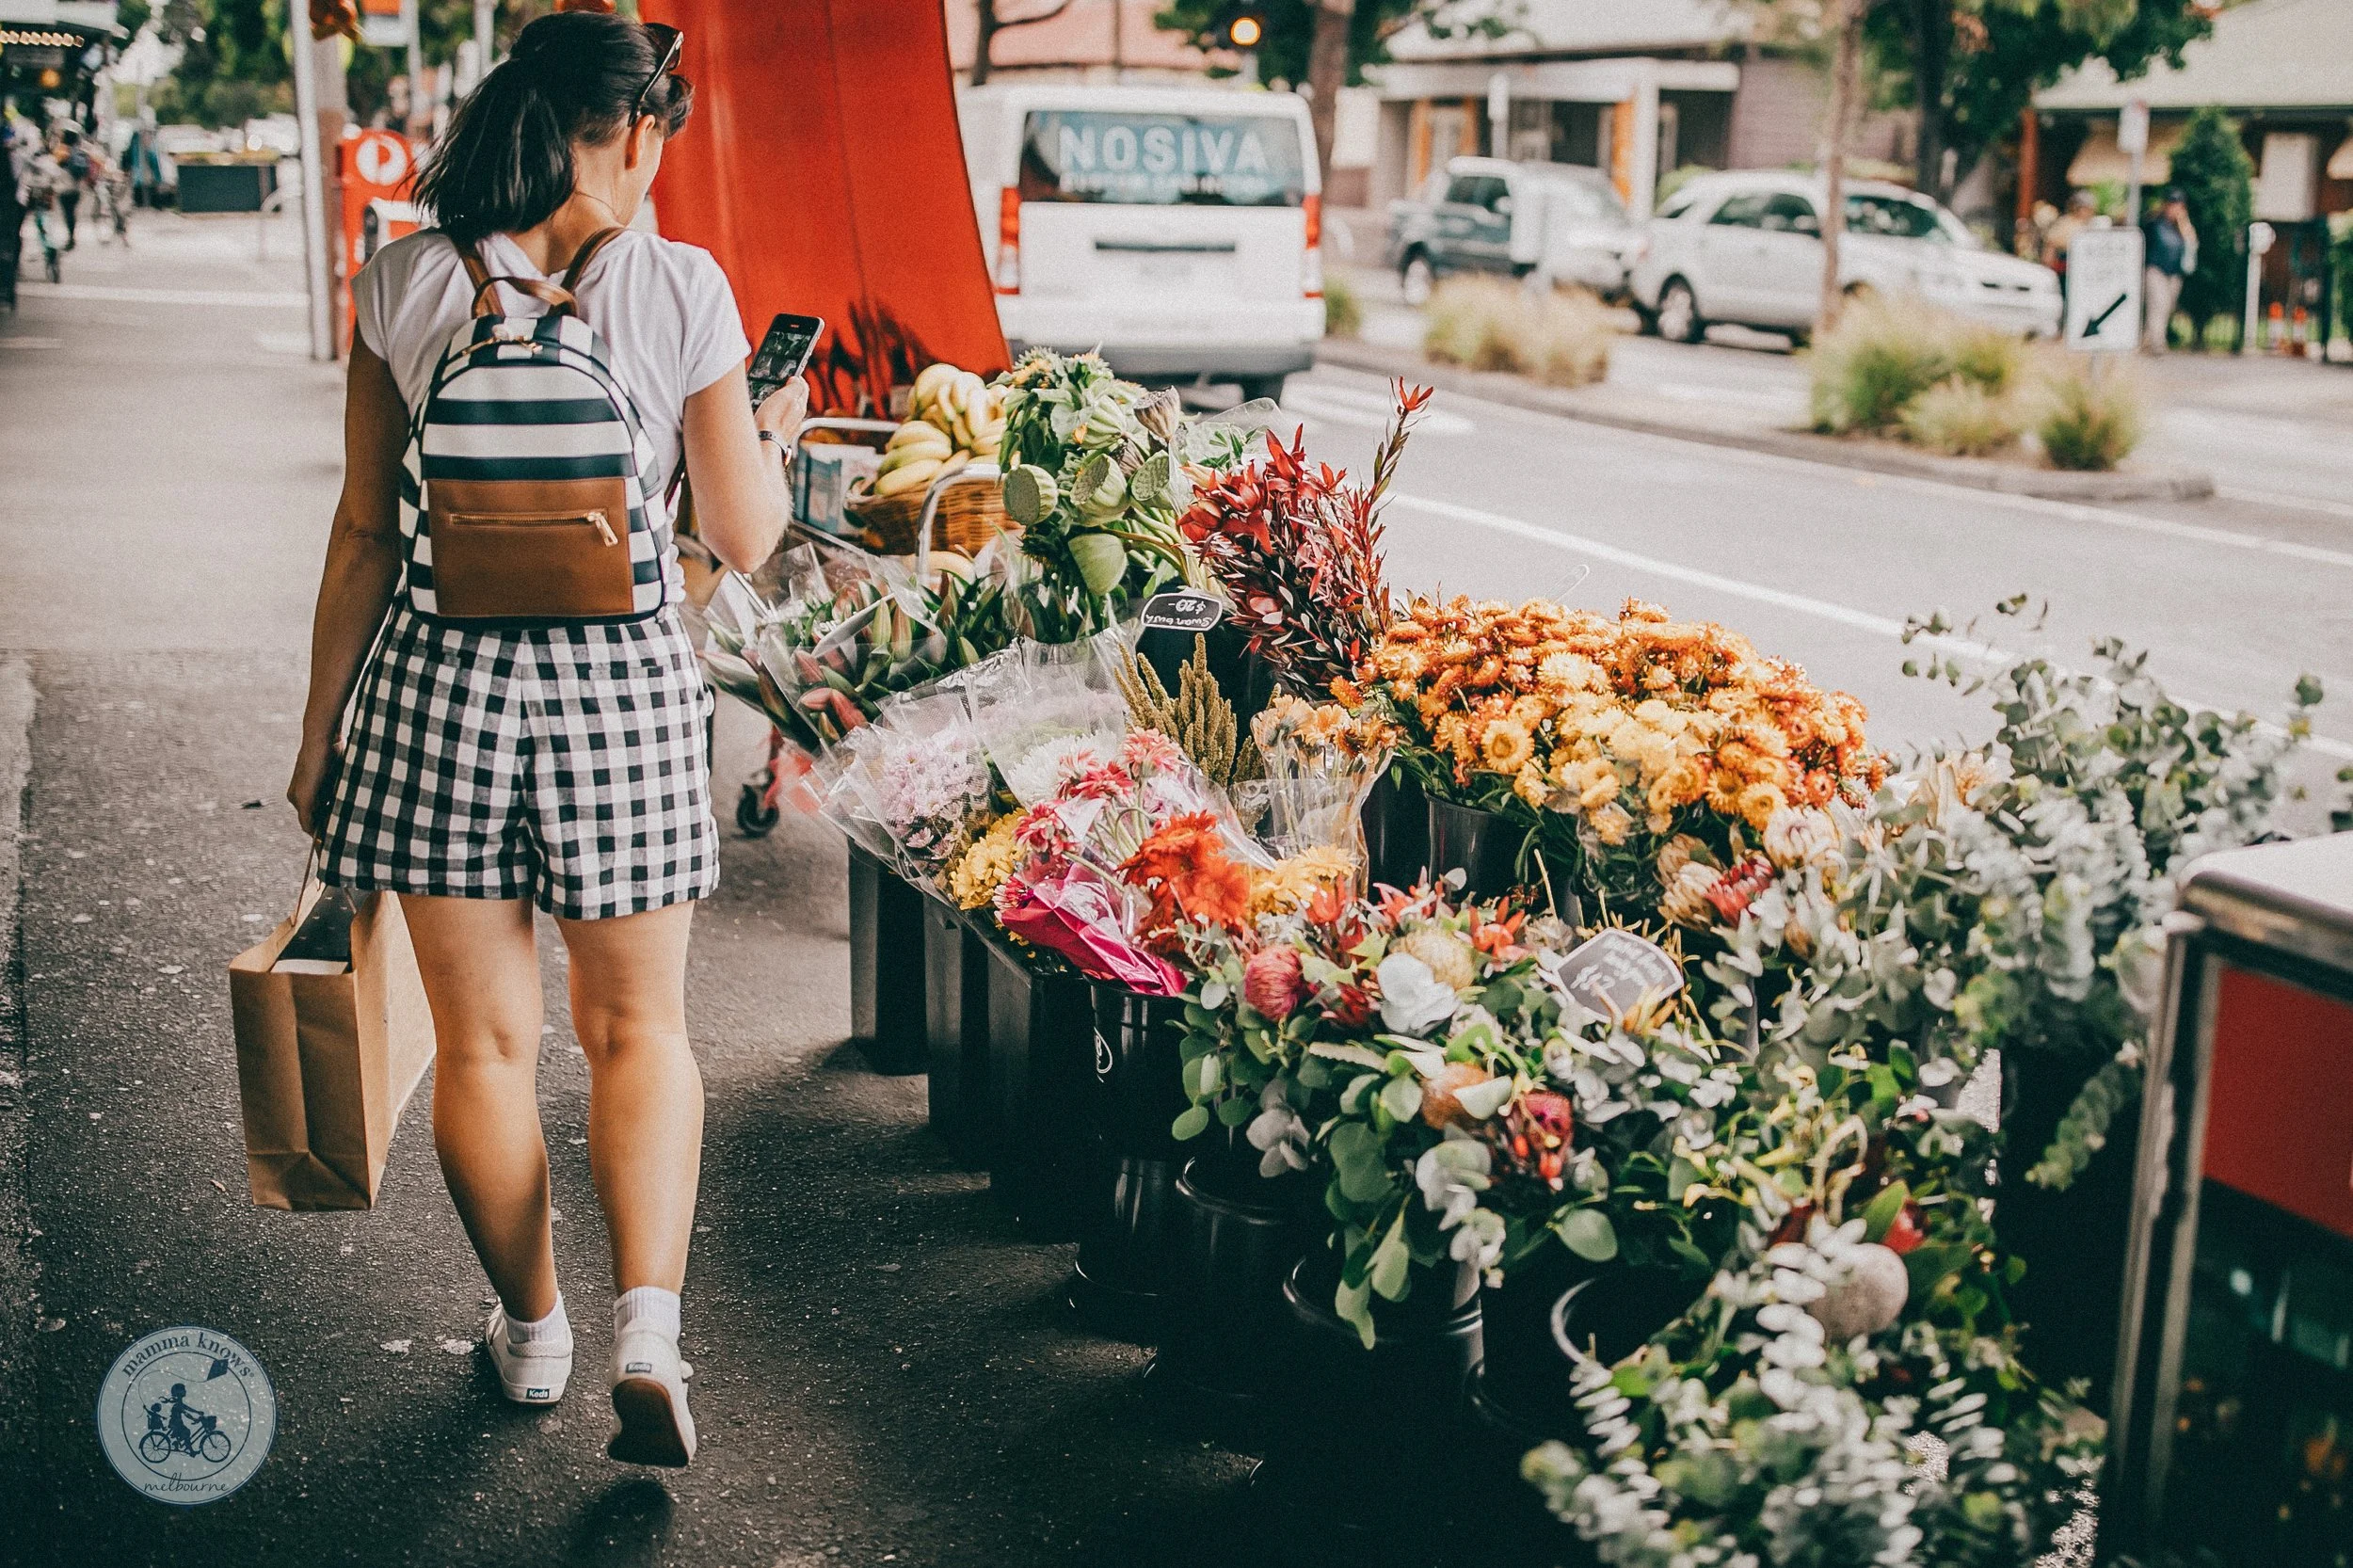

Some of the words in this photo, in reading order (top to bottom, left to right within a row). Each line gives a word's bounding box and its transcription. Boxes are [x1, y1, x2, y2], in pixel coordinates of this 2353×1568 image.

[1060, 124, 1269, 173] NOSIVA
[1145, 614, 1174, 625] bush
[1176, 616, 1212, 627] Swan
[528, 1389, 549, 1399] Keds
